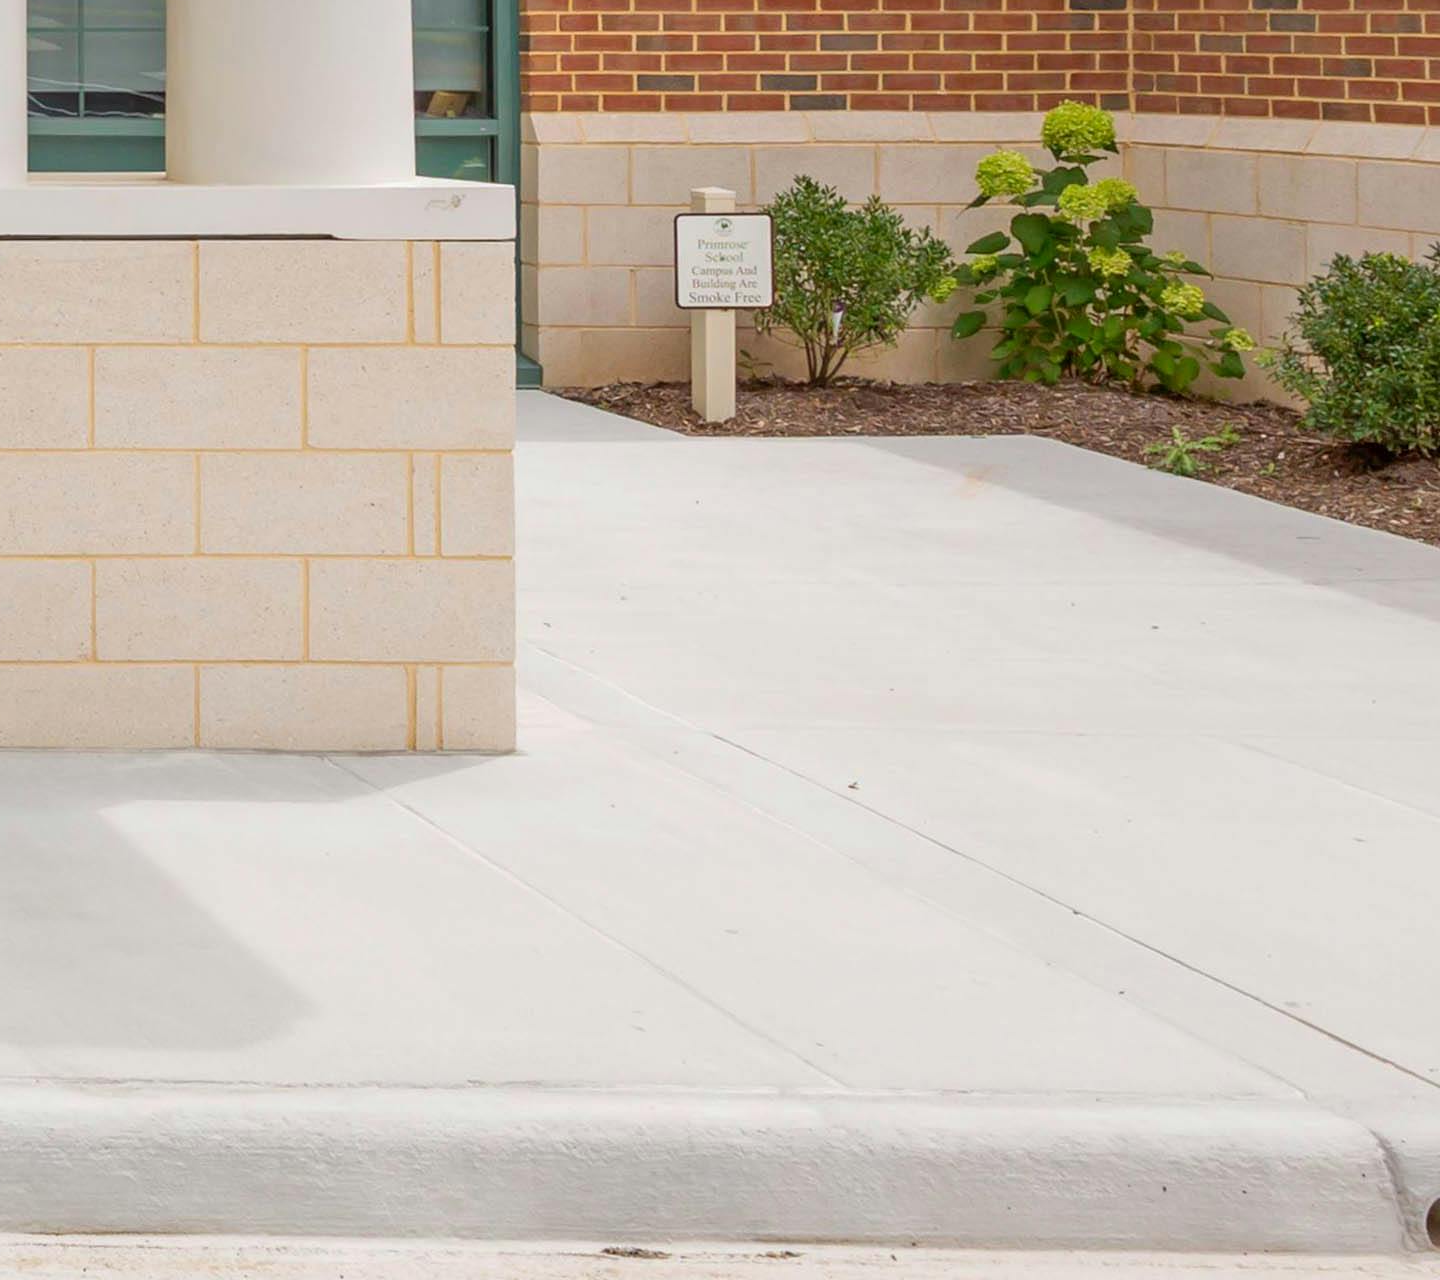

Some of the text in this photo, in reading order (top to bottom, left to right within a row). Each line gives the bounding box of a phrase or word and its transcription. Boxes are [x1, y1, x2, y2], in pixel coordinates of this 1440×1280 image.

[704, 251, 744, 263] School
[691, 265, 758, 277] Campus And
[692, 279, 759, 291] Building Are
[688, 291, 762, 304] Smoke Free
